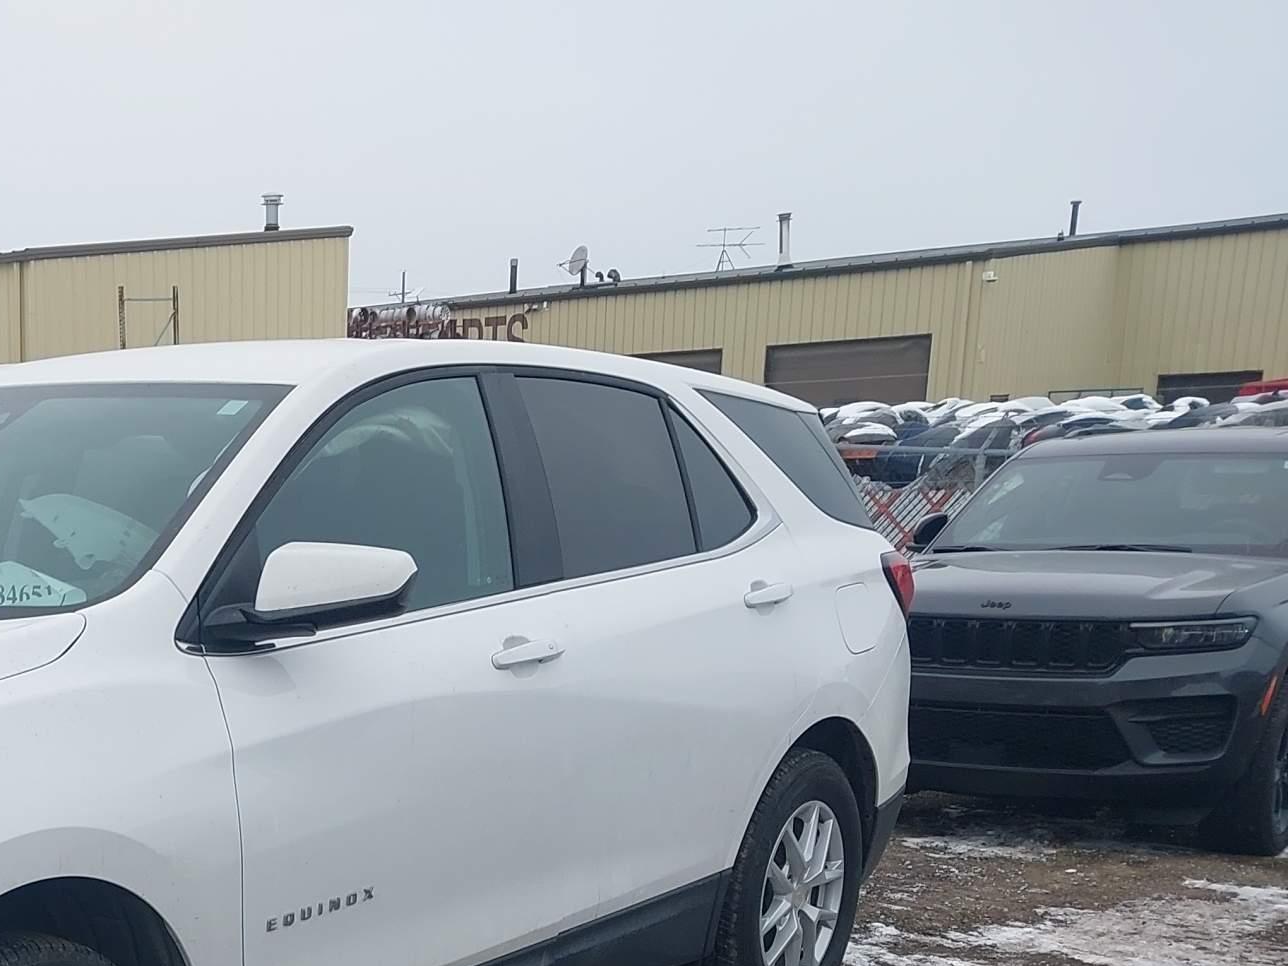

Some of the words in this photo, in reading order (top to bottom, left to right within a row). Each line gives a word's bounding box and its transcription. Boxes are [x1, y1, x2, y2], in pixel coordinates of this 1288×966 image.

[438, 313, 528, 342] ARTS
[980, 600, 1012, 610] Jeep
[265, 886, 375, 932] EQUINOX
